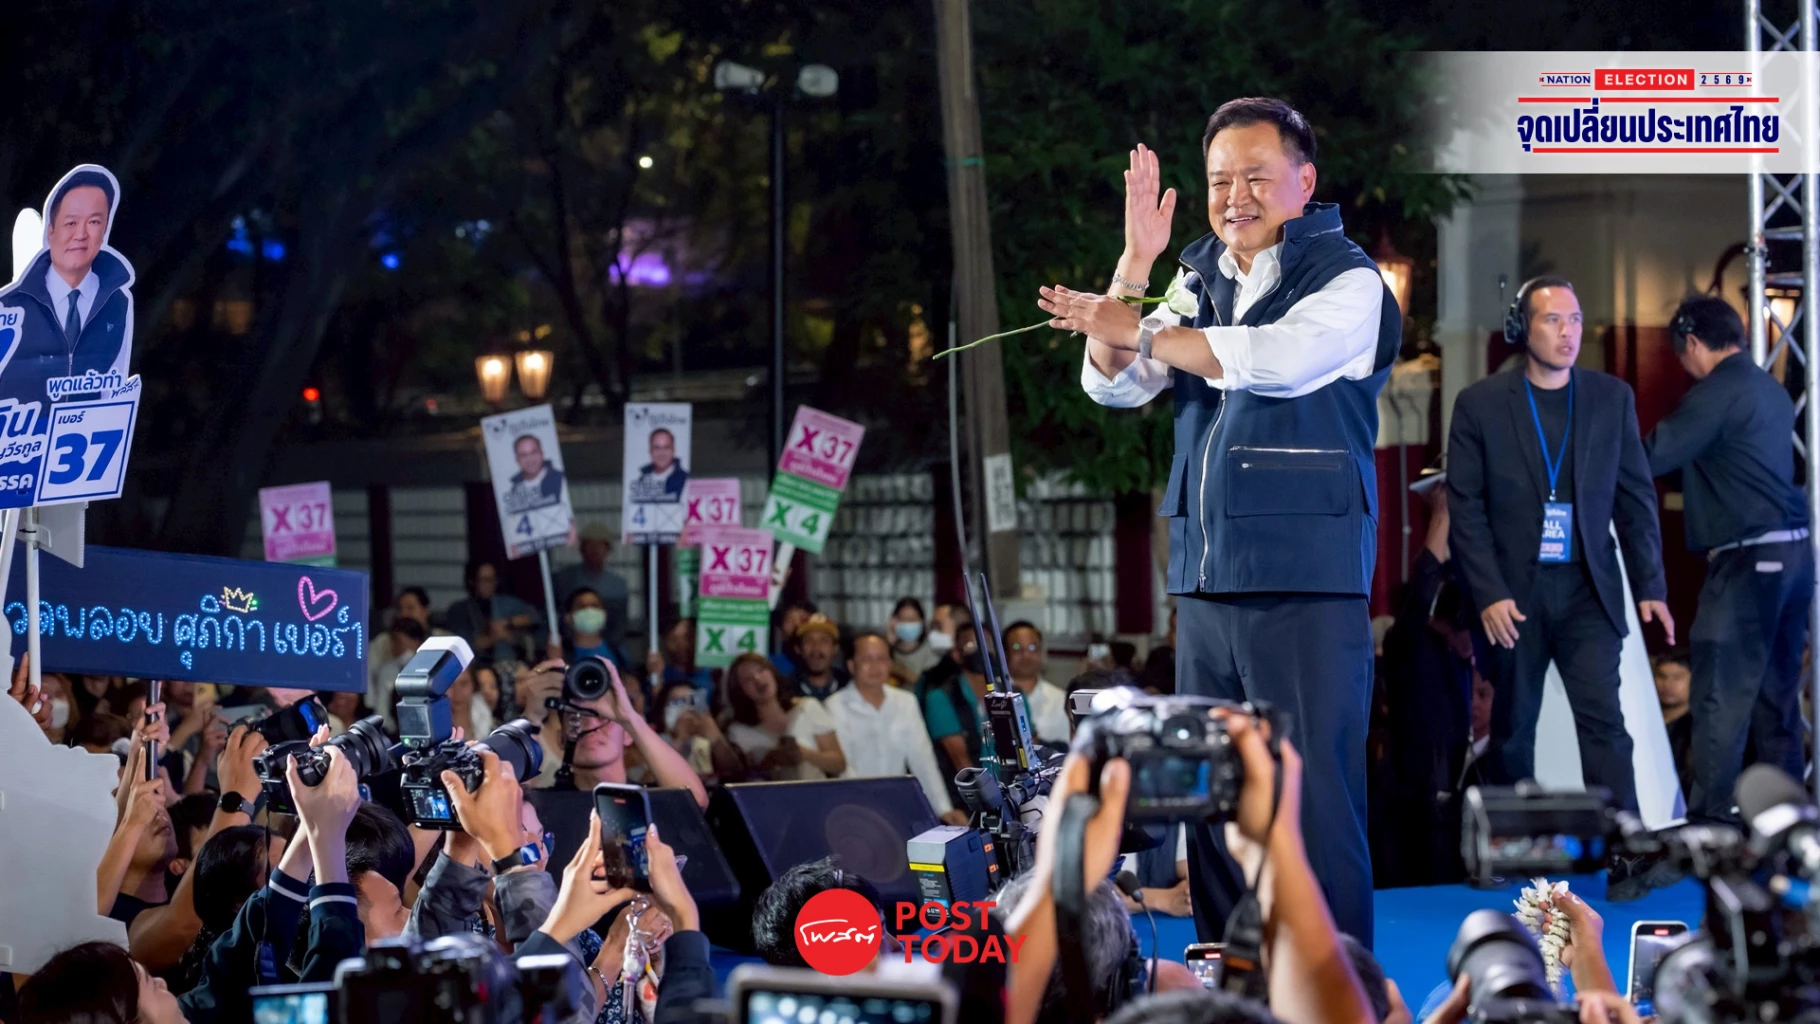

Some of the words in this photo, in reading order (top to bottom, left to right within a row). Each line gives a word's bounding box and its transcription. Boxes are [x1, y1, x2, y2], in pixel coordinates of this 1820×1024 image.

[49, 369, 122, 398] พูดแล้วทำ
[58, 411, 85, 424] เบอร์
[48, 429, 123, 485] 37
[823, 436, 853, 462] 37
[300, 503, 327, 530] 37
[631, 504, 648, 528] 4
[708, 498, 736, 521] 37
[516, 514, 533, 537] 4
[801, 513, 819, 535] 4
[1542, 530, 1565, 539] REA
[739, 548, 767, 572] 37
[737, 629, 757, 653] 4
